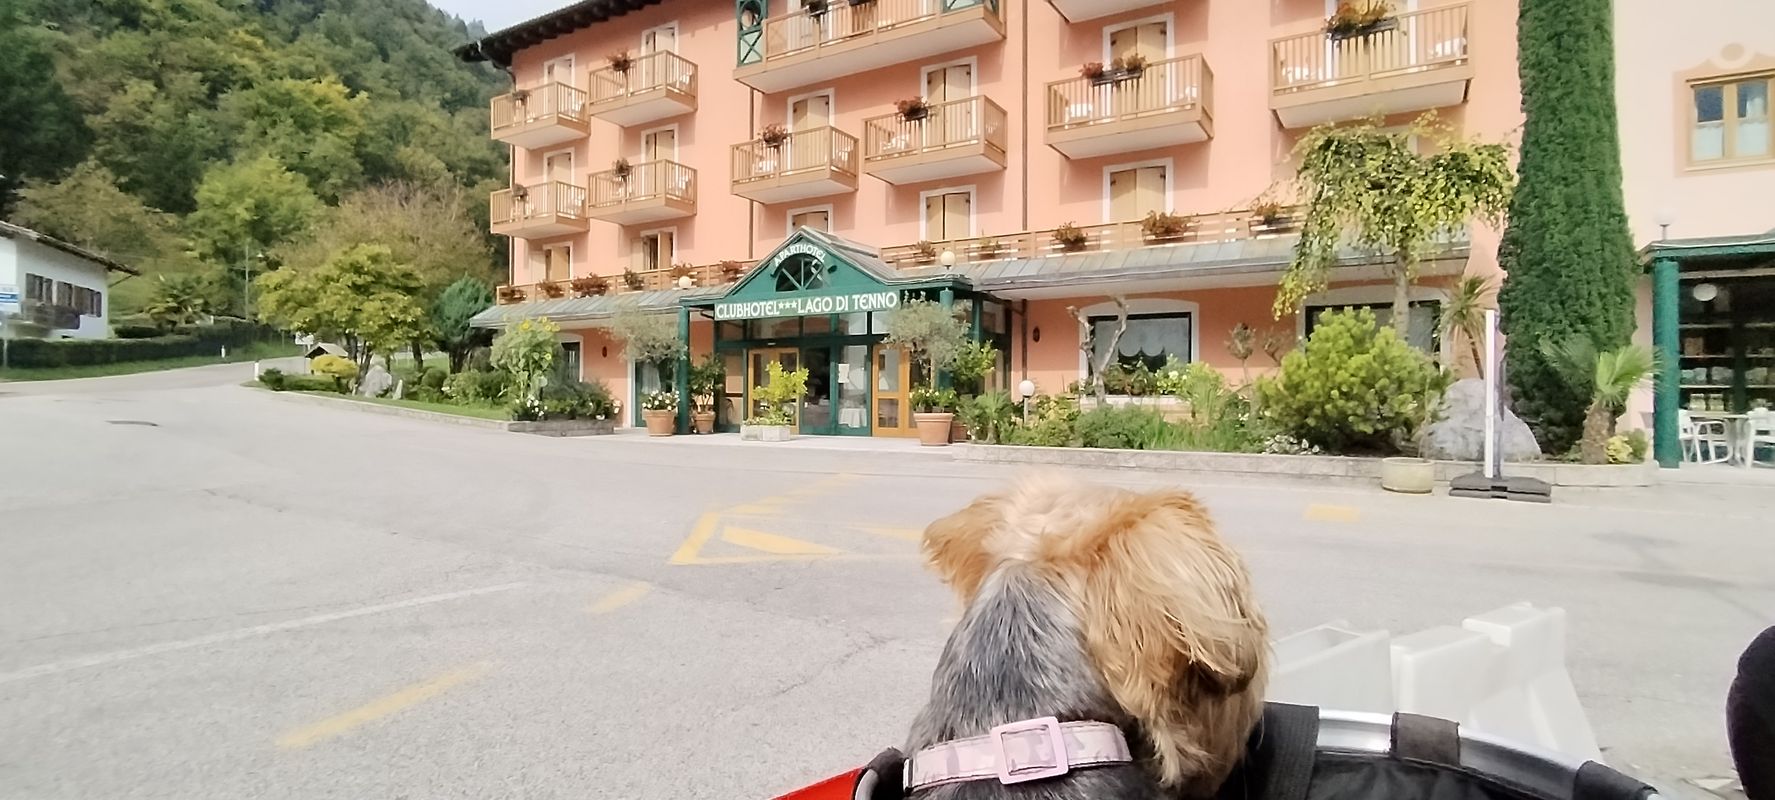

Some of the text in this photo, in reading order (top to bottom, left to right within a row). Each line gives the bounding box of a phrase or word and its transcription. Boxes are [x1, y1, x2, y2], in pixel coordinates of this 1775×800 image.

[774, 243, 826, 267] APARTHOTEL
[797, 297, 832, 314] LAGO
[837, 295, 849, 311] DI
[852, 291, 898, 310] TENNO
